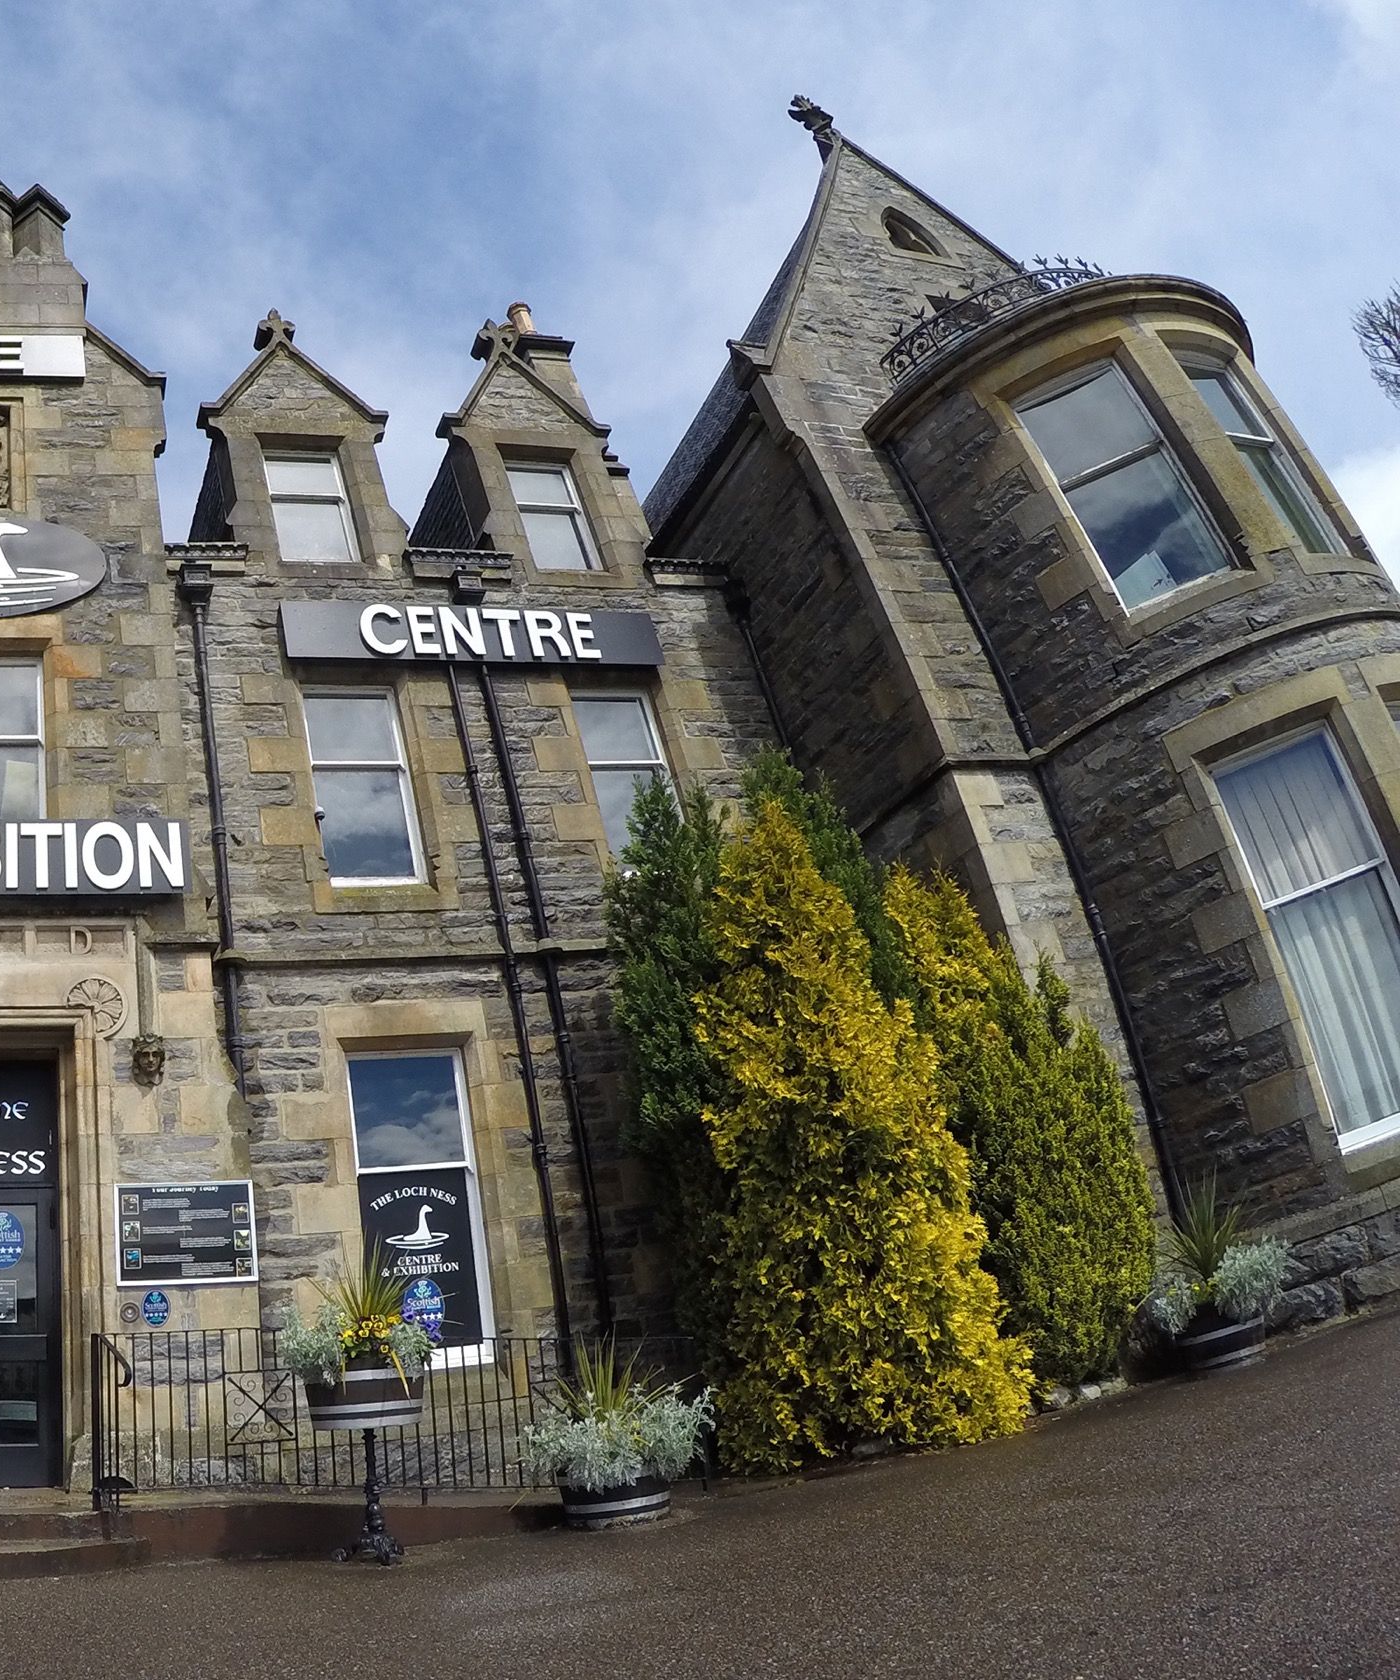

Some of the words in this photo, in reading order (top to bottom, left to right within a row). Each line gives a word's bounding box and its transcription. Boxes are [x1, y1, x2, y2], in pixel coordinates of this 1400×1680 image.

[359, 603, 602, 660] CENTRE
[69, 926, 93, 955] D
[369, 1192, 394, 1211] THE
[394, 1186, 428, 1199] LOCH
[429, 1187, 457, 1205] NESS
[381, 1267, 391, 1278] &
[393, 1261, 460, 1276] EXHIBITION
[397, 1253, 443, 1266] CENTRE
